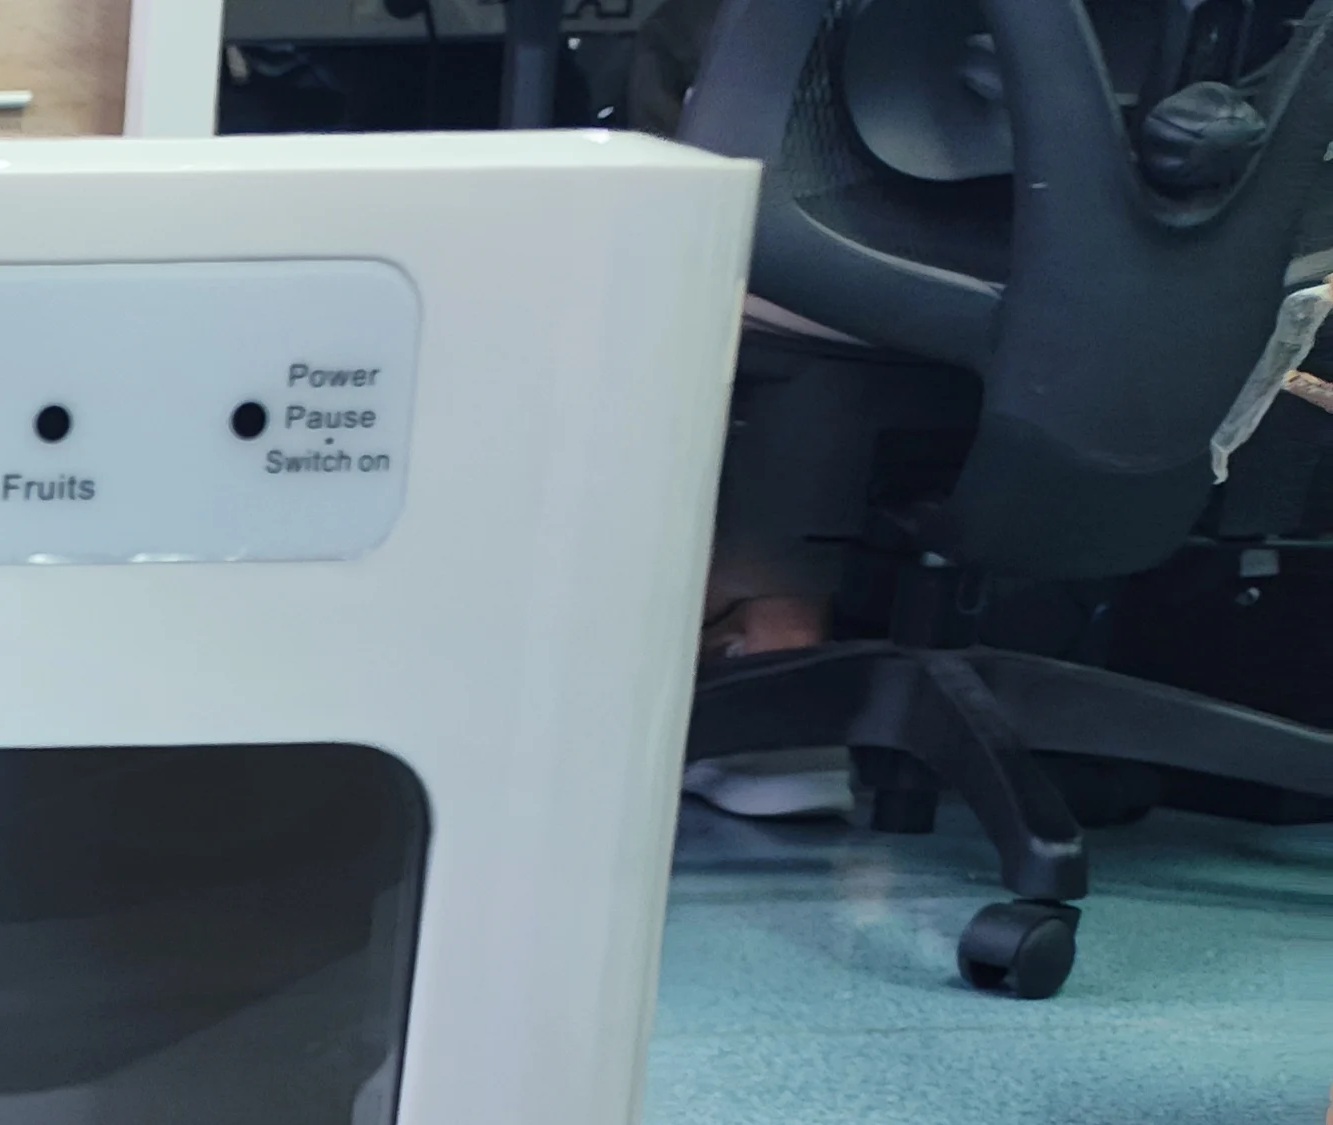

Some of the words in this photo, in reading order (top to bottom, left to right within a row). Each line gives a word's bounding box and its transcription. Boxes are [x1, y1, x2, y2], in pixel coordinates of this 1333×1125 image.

[287, 362, 382, 389] Power
[284, 403, 377, 430] Pause
[264, 448, 351, 476] Switch
[356, 453, 391, 474] on
[0, 471, 97, 502] Fruits
